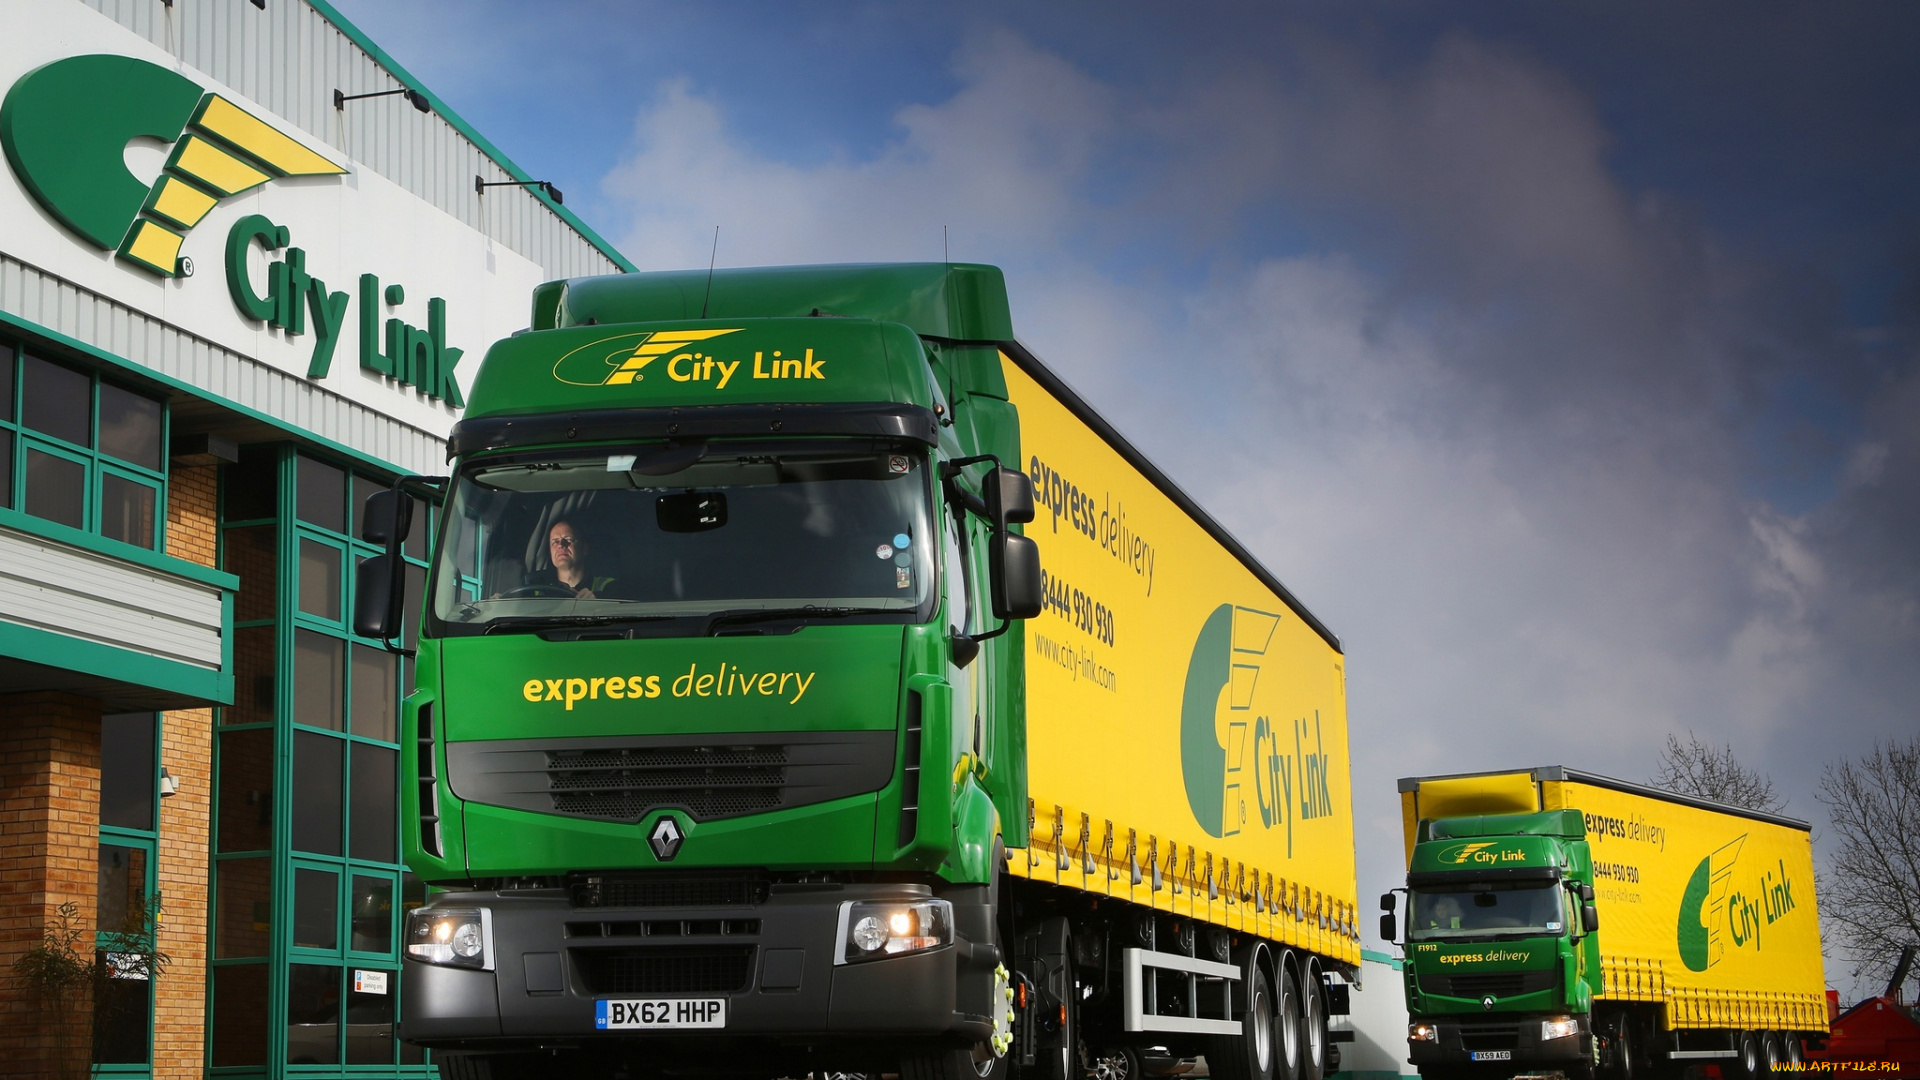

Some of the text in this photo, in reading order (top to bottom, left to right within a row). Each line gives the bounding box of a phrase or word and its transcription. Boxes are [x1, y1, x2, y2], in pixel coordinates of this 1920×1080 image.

[225, 214, 465, 409] City Link
[667, 348, 826, 389] City Link
[1030, 455, 1155, 597] express delivery
[1041, 568, 1114, 648] 8444 930 930
[1034, 631, 1117, 693] www.city-link.com
[523, 662, 816, 711] express delivery
[1254, 709, 1333, 859] City Link
[1585, 812, 1666, 853] express delivery
[1474, 849, 1526, 864] City Link
[1612, 864, 1626, 882] 930
[1626, 866, 1640, 884] 930
[1729, 859, 1796, 952] City Link
[1440, 950, 1530, 966] express delivery
[611, 1001, 720, 1024] BX62 HHP
[1476, 1052, 1494, 1060] BX59
